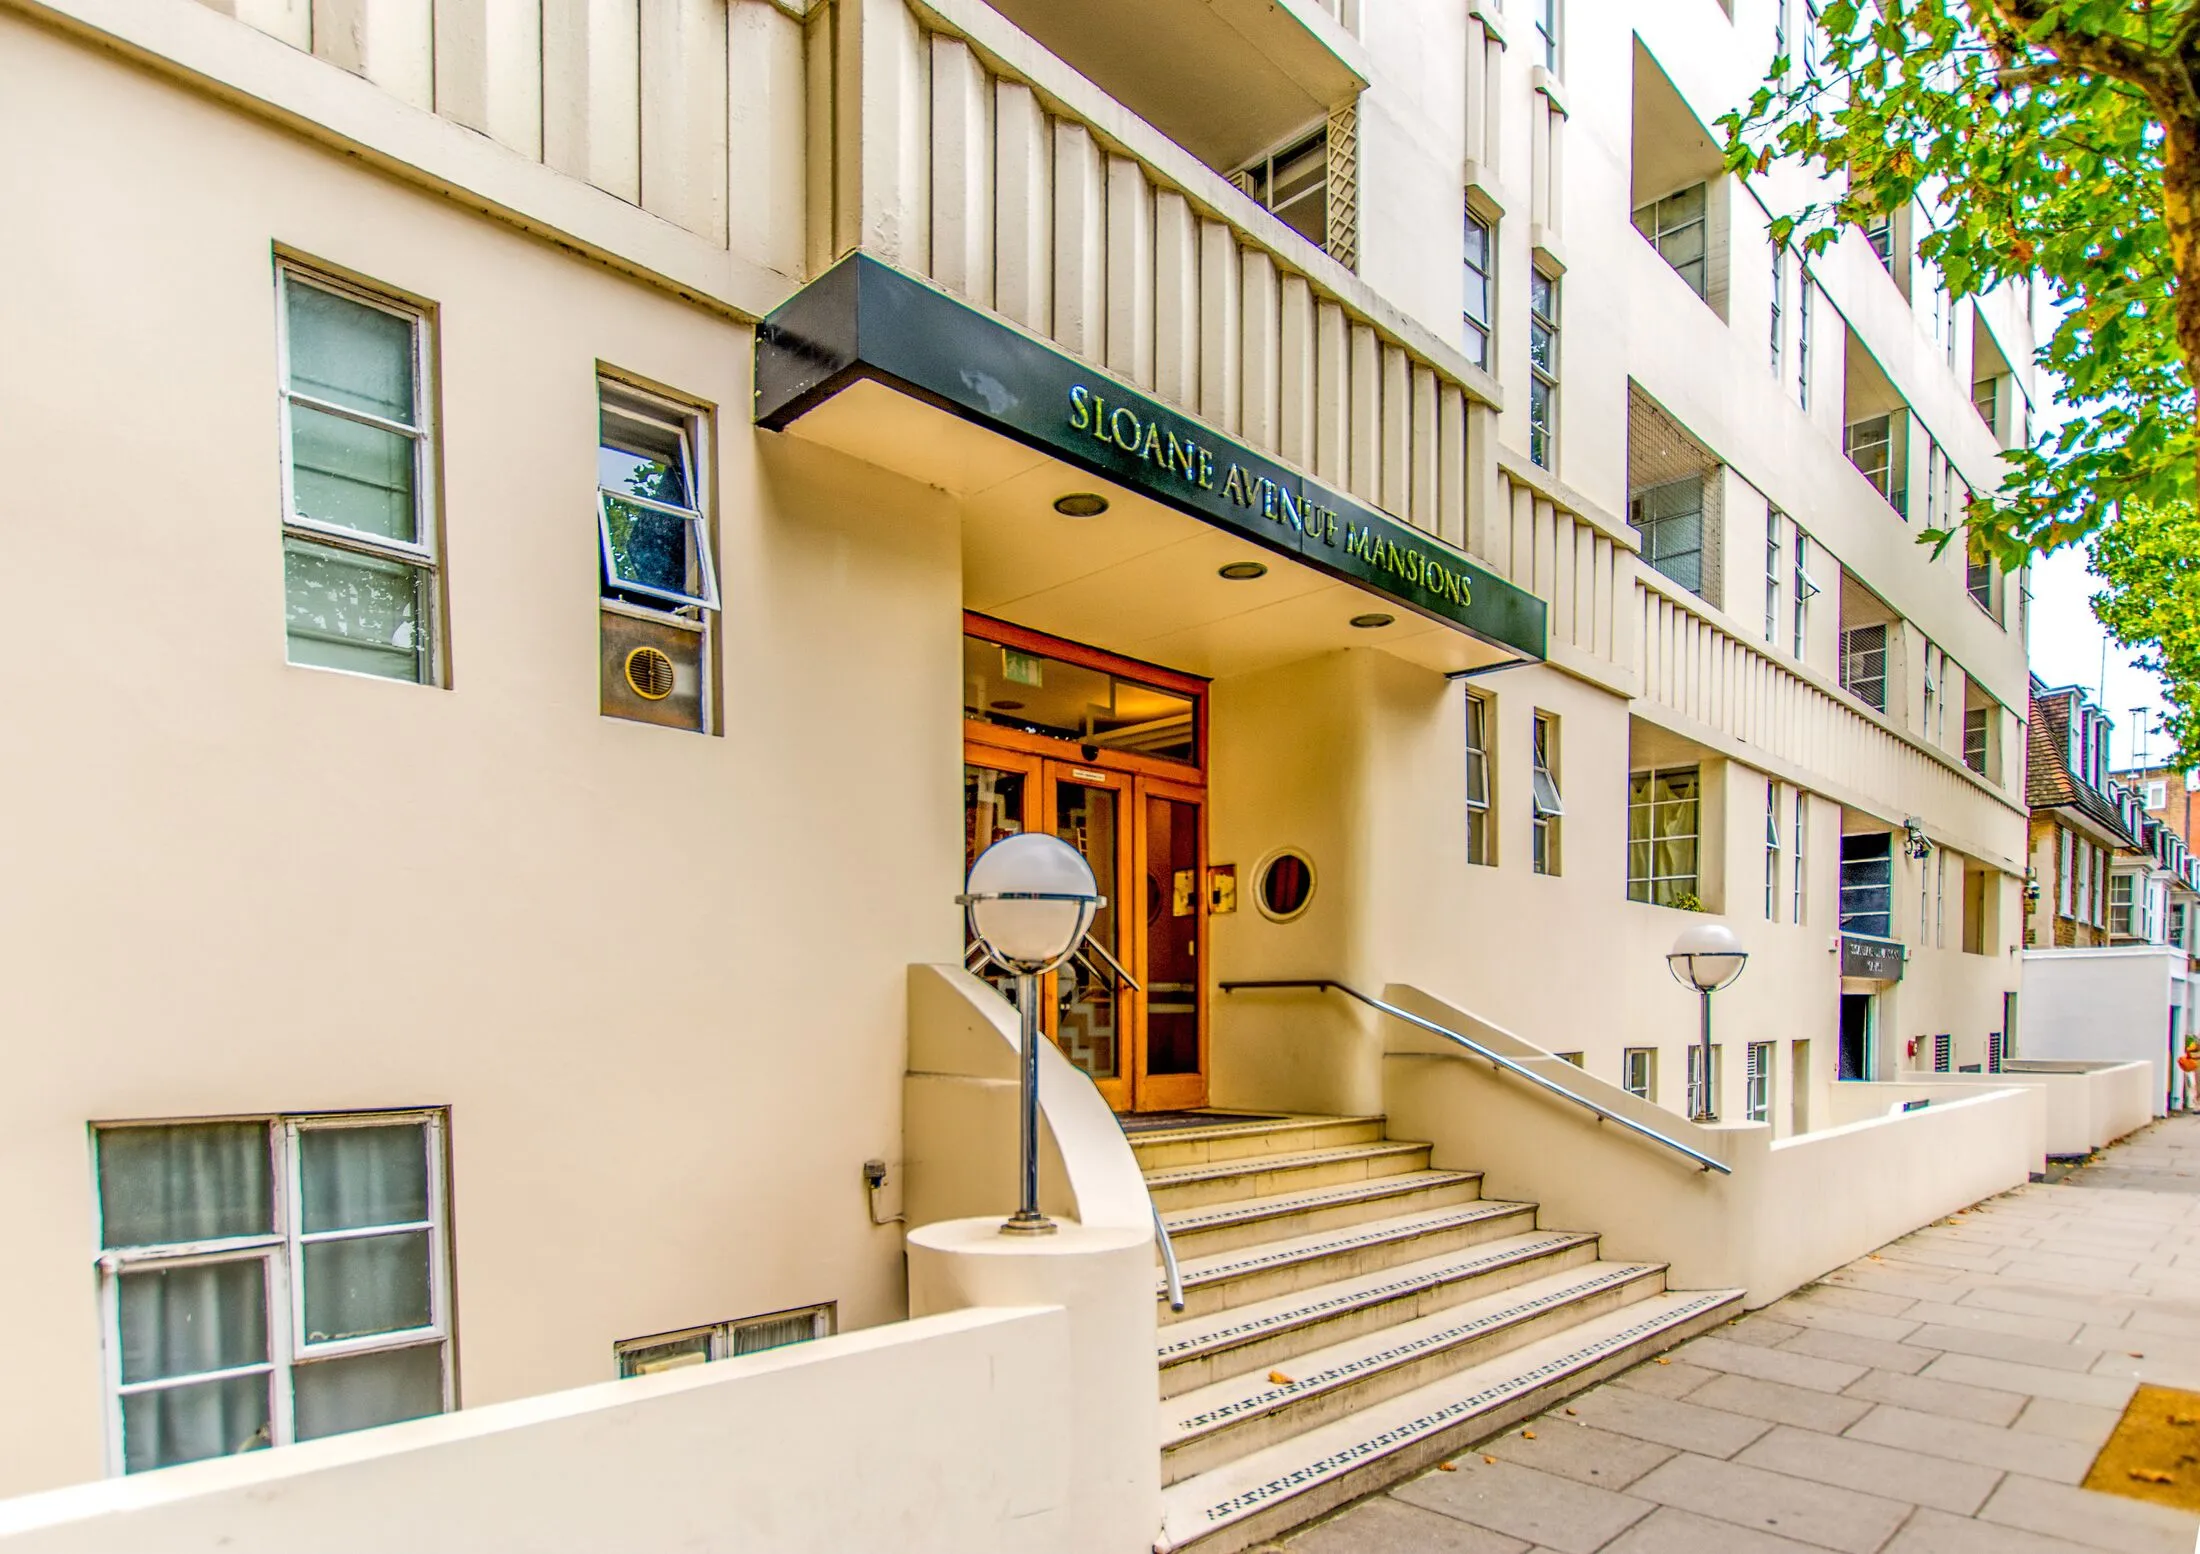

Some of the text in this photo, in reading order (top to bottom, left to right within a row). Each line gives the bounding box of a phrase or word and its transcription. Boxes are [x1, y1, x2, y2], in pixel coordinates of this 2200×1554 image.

[1069, 384, 1472, 607] SLOANE AVENUE MANSIONS
